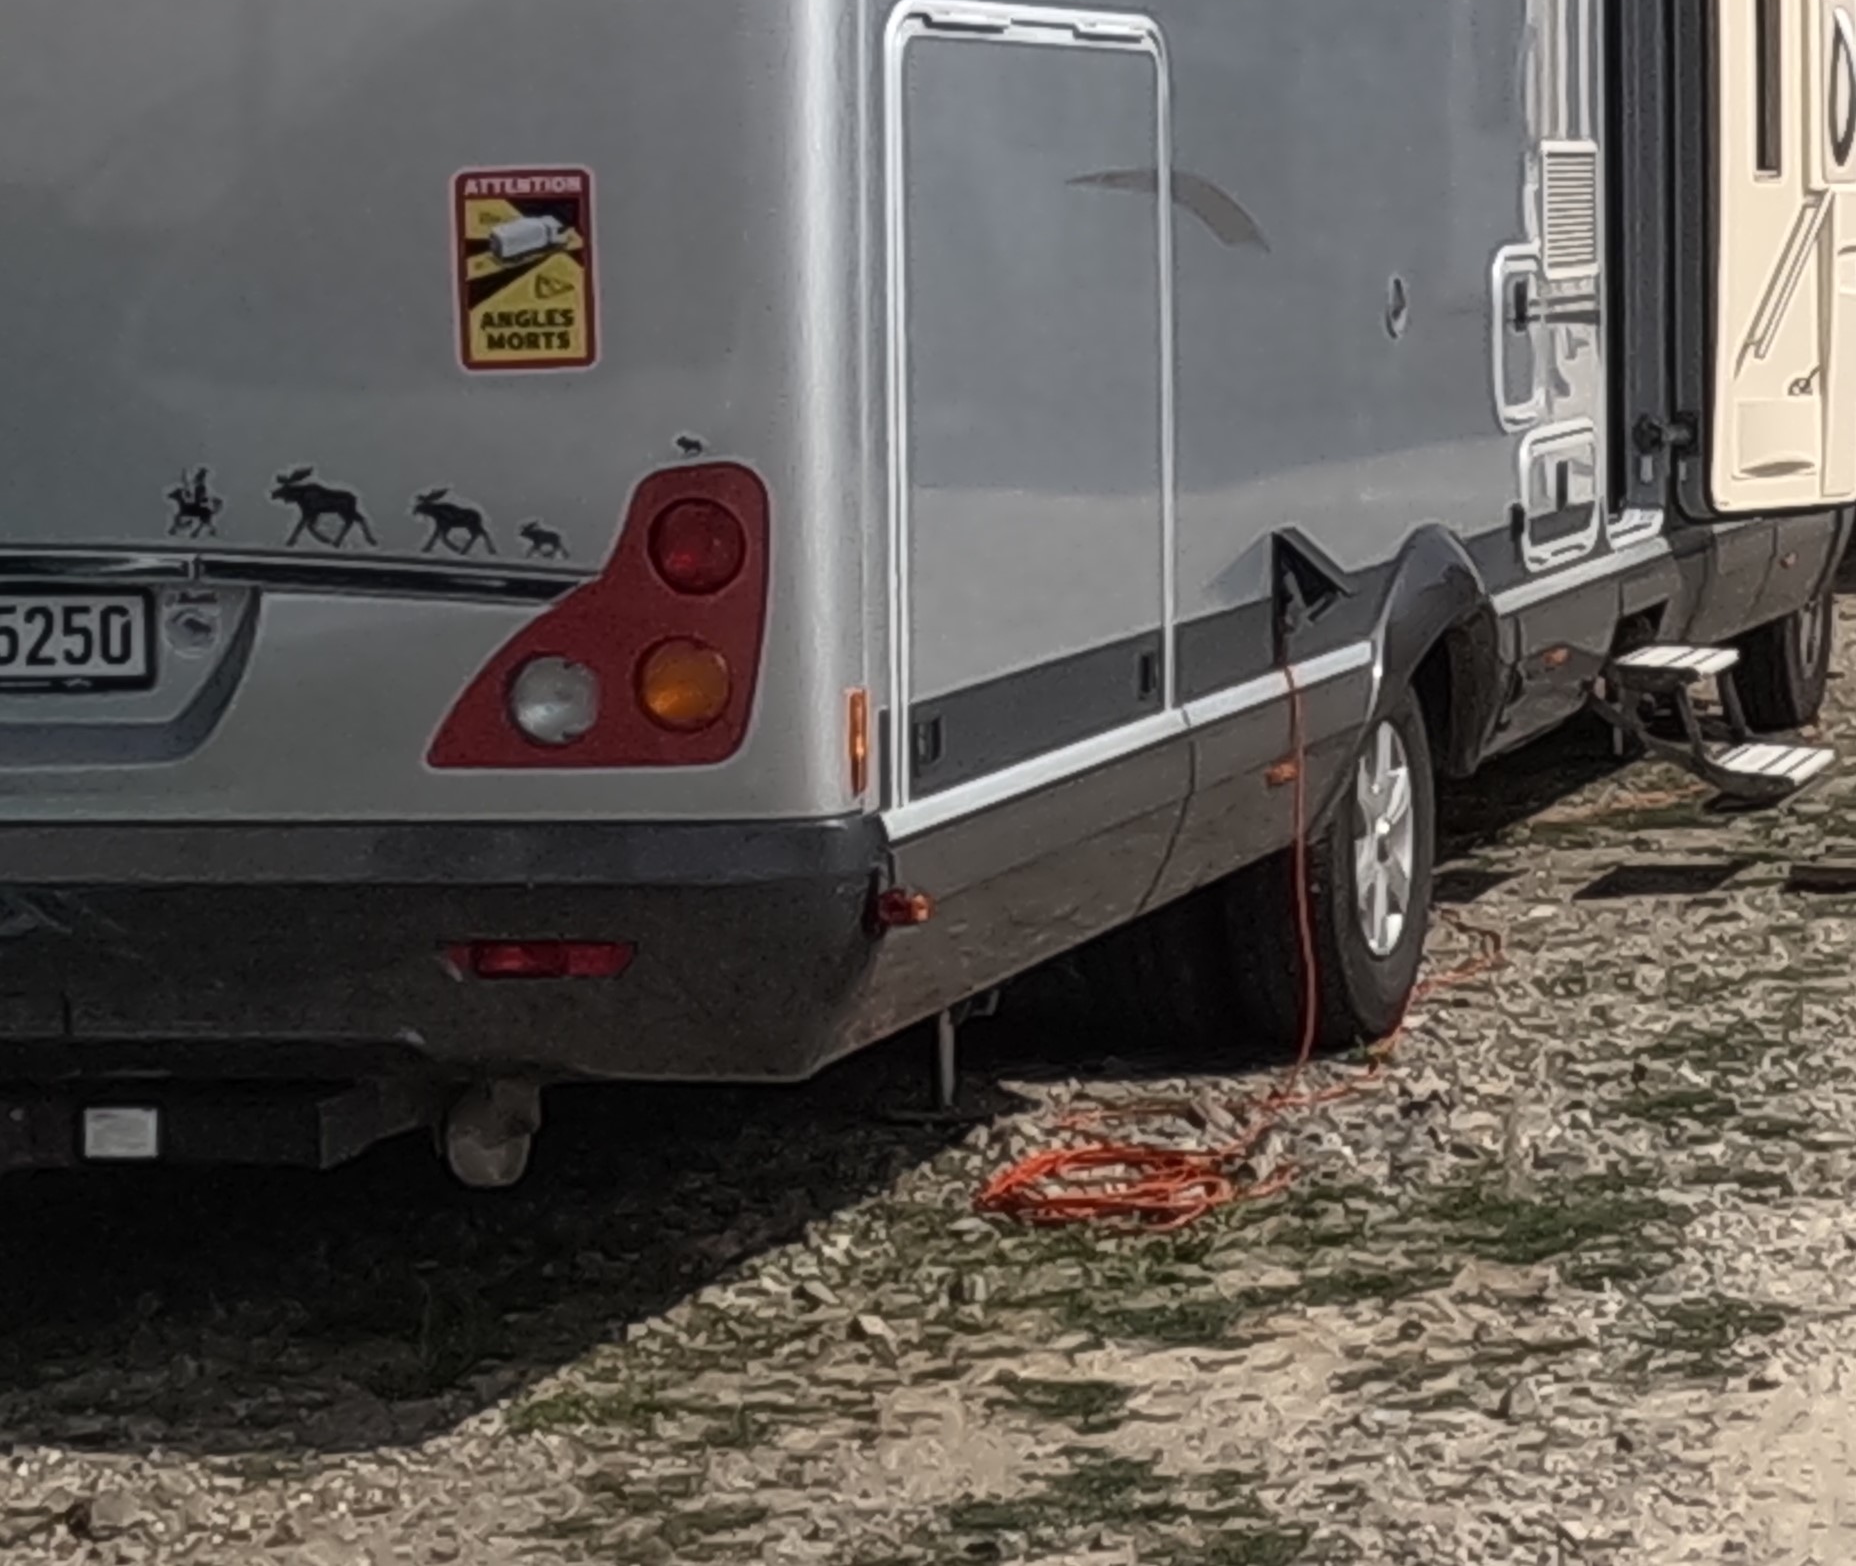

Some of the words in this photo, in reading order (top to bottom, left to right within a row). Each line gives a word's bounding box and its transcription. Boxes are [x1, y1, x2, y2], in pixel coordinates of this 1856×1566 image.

[464, 176, 582, 197] ATTENTION
[480, 308, 575, 331] ANGLES
[486, 331, 571, 351] MORTS
[0, 604, 132, 666] 5250
